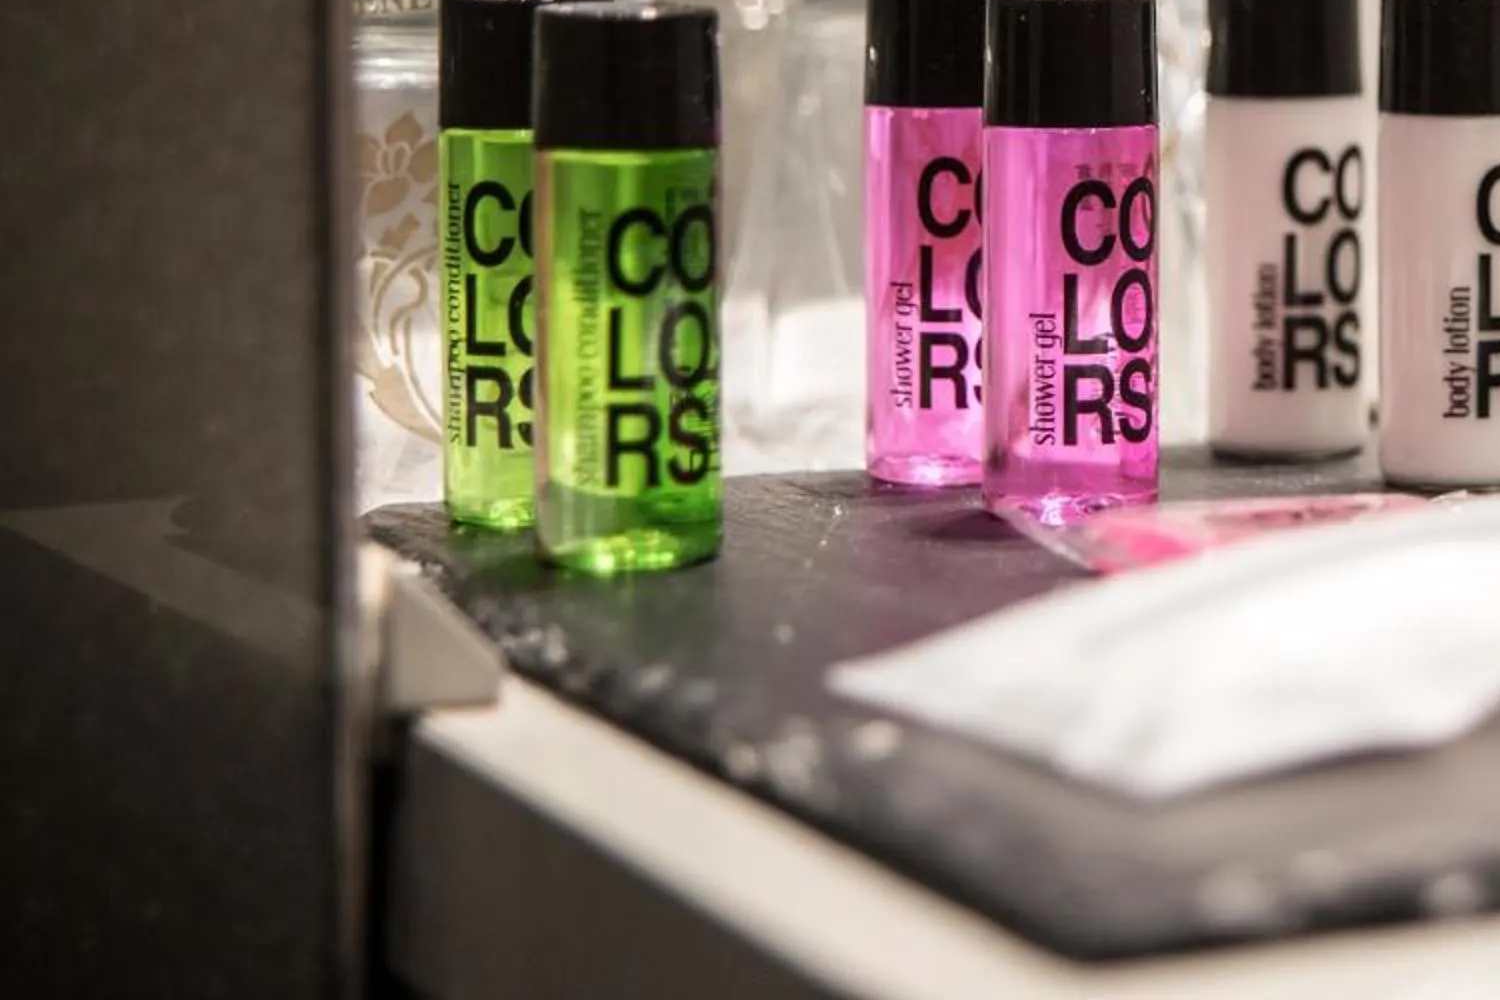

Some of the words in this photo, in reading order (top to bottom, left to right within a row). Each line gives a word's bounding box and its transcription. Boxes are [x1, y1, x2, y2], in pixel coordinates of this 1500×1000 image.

[917, 156, 982, 238] C
[1061, 177, 1155, 266] CO
[1282, 144, 1362, 226] CO
[444, 182, 463, 324] conditioner
[607, 205, 715, 297] CO
[1283, 227, 1361, 308] LO
[890, 281, 918, 315] gel
[1029, 313, 1062, 349] gel
[1063, 268, 1153, 355] LO
[1251, 262, 1278, 331] lotion
[1443, 286, 1472, 354] lotion
[608, 302, 710, 390] LO
[890, 322, 914, 408] shower
[919, 332, 982, 409] R
[1251, 335, 1281, 391] body
[1282, 311, 1361, 392] RS
[1029, 354, 1056, 446] shower
[1063, 358, 1152, 446] RS
[1443, 361, 1476, 418] body
[606, 400, 710, 489] RS
